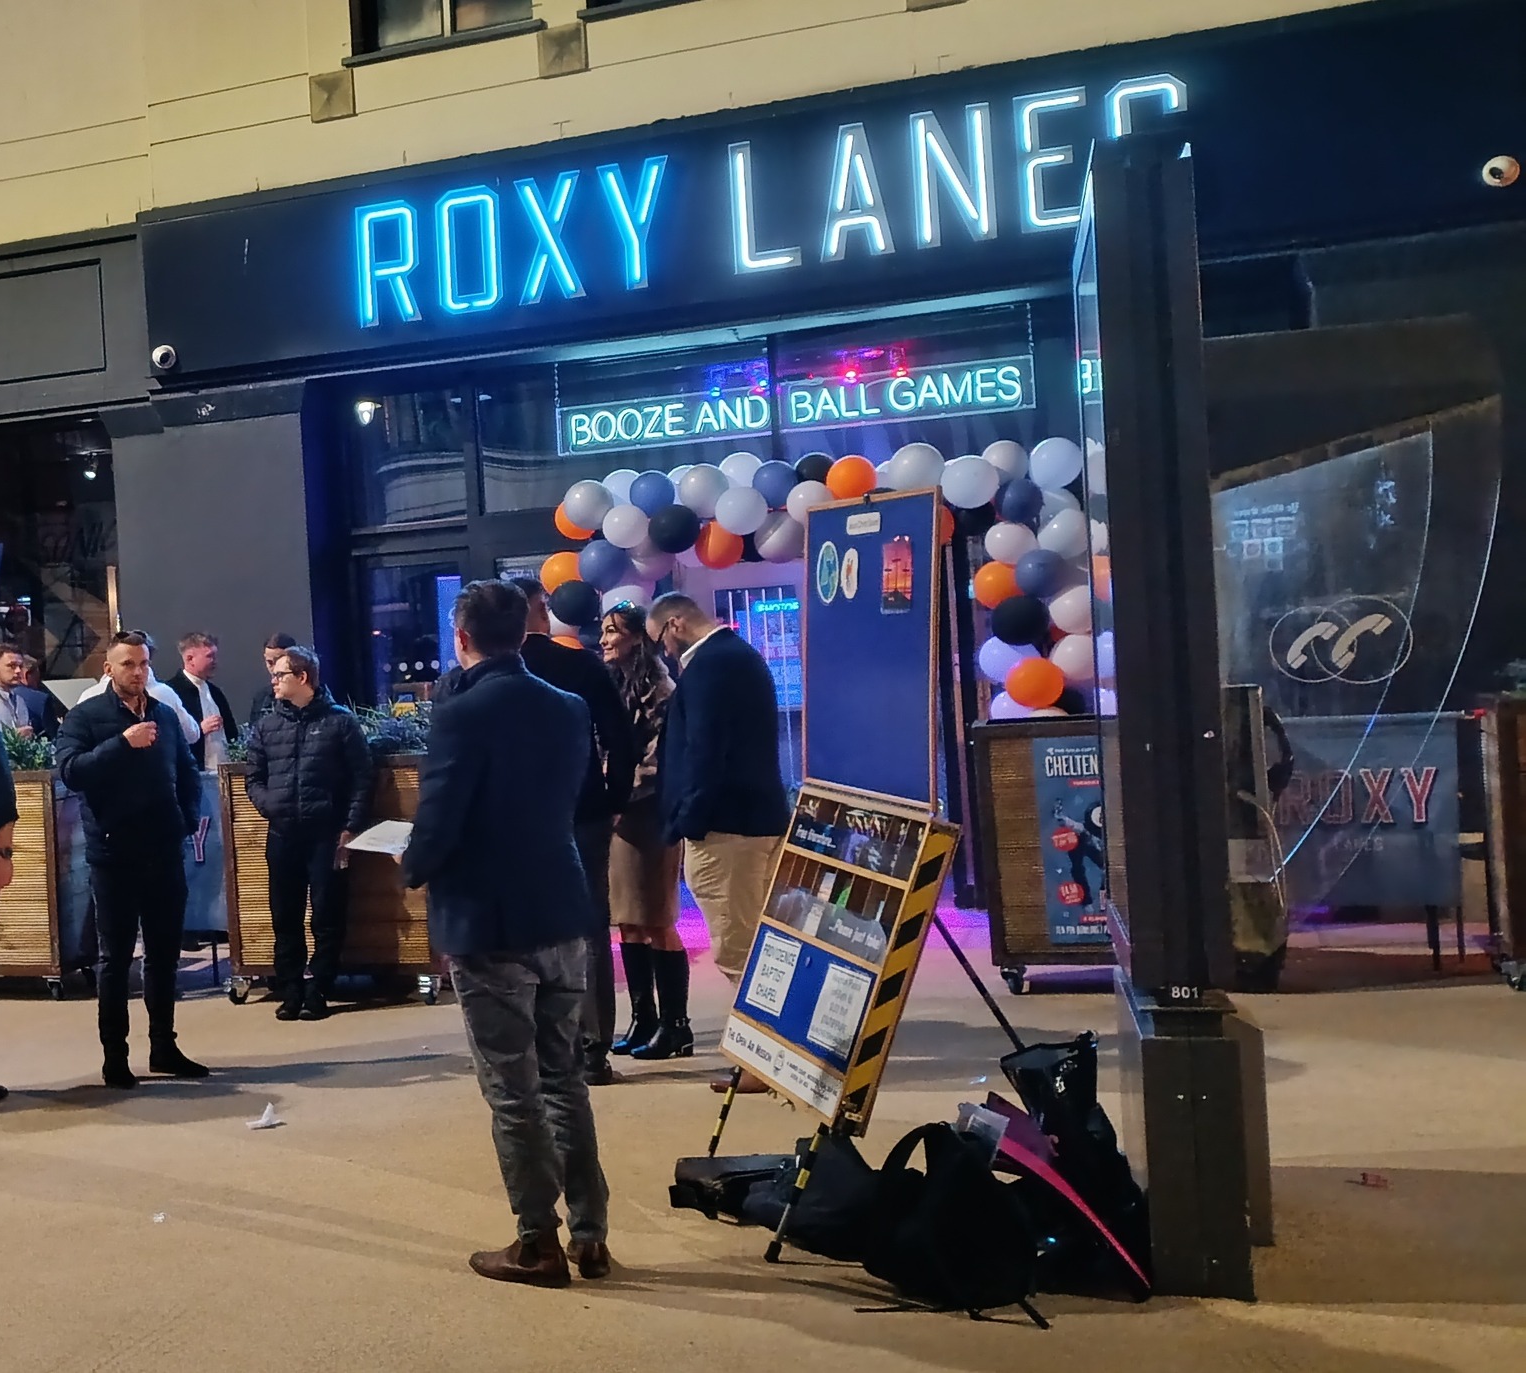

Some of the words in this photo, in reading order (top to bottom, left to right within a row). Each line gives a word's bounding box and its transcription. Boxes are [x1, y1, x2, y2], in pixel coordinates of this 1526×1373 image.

[354, 154, 668, 330] ROXY
[570, 403, 684, 446] BOOZE
[694, 395, 770, 433] AND
[790, 383, 881, 424] BALL
[888, 366, 1022, 411] GAMES
[1044, 754, 1099, 777] CHELTEN
[1278, 766, 1437, 825] ROXY
[1171, 986, 1199, 999] 801
